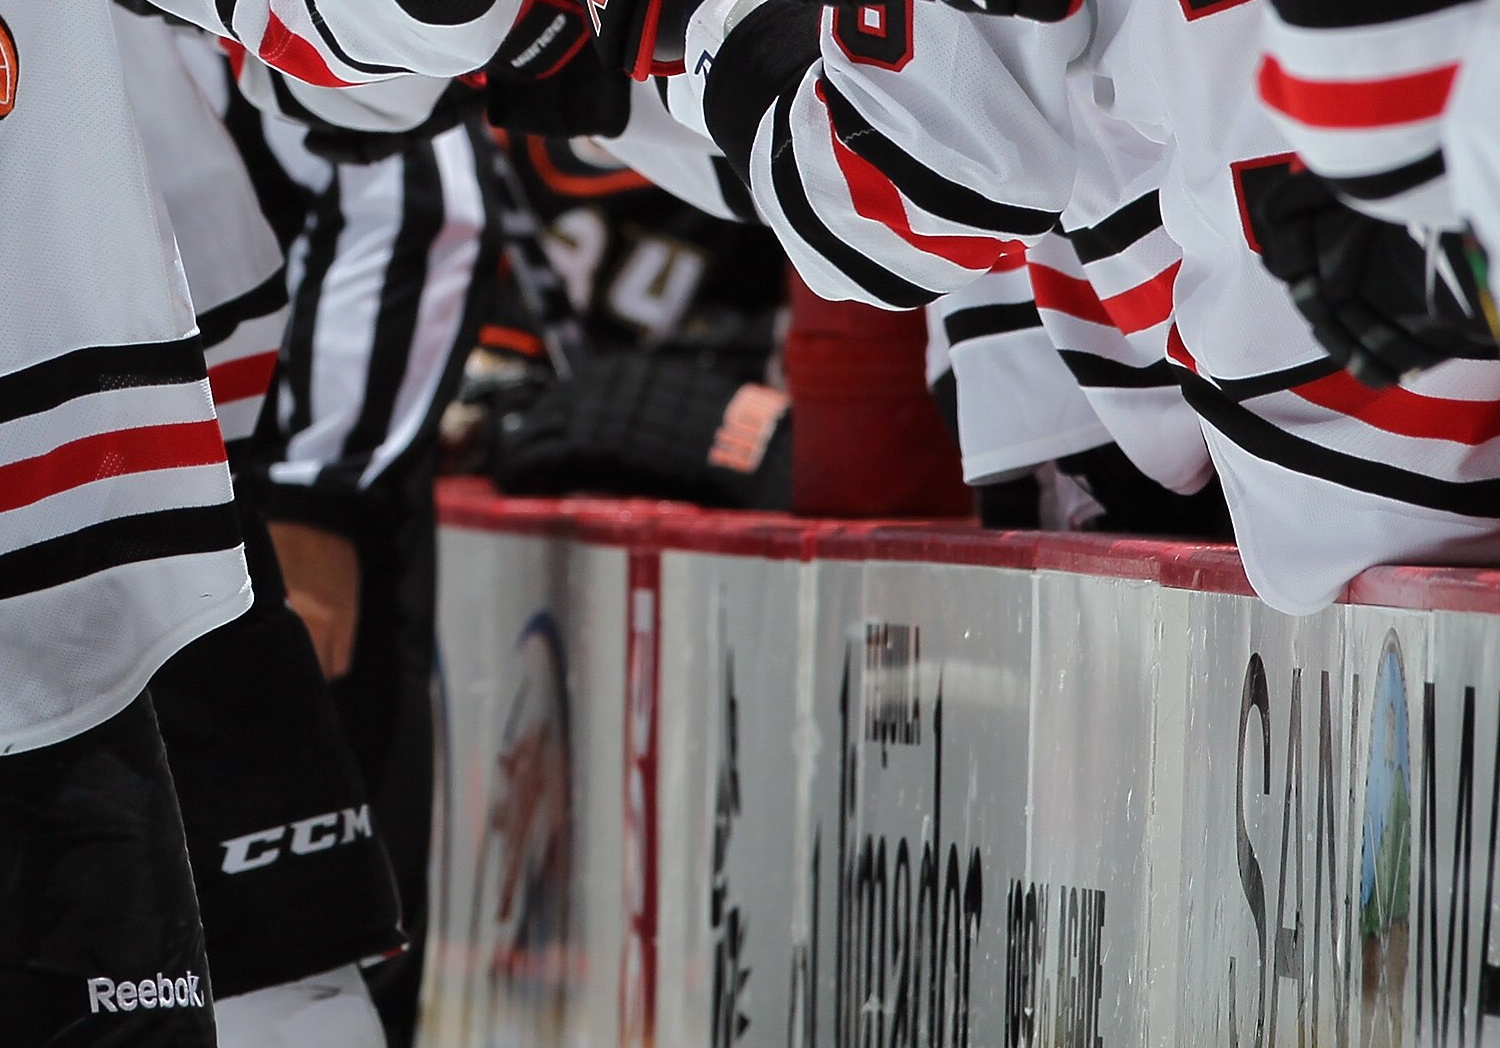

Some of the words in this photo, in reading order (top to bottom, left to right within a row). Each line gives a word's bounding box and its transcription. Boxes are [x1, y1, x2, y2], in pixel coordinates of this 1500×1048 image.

[219, 803, 372, 875] CCM
[1228, 652, 1359, 1048] SAN
[87, 970, 205, 1014] Reebok
